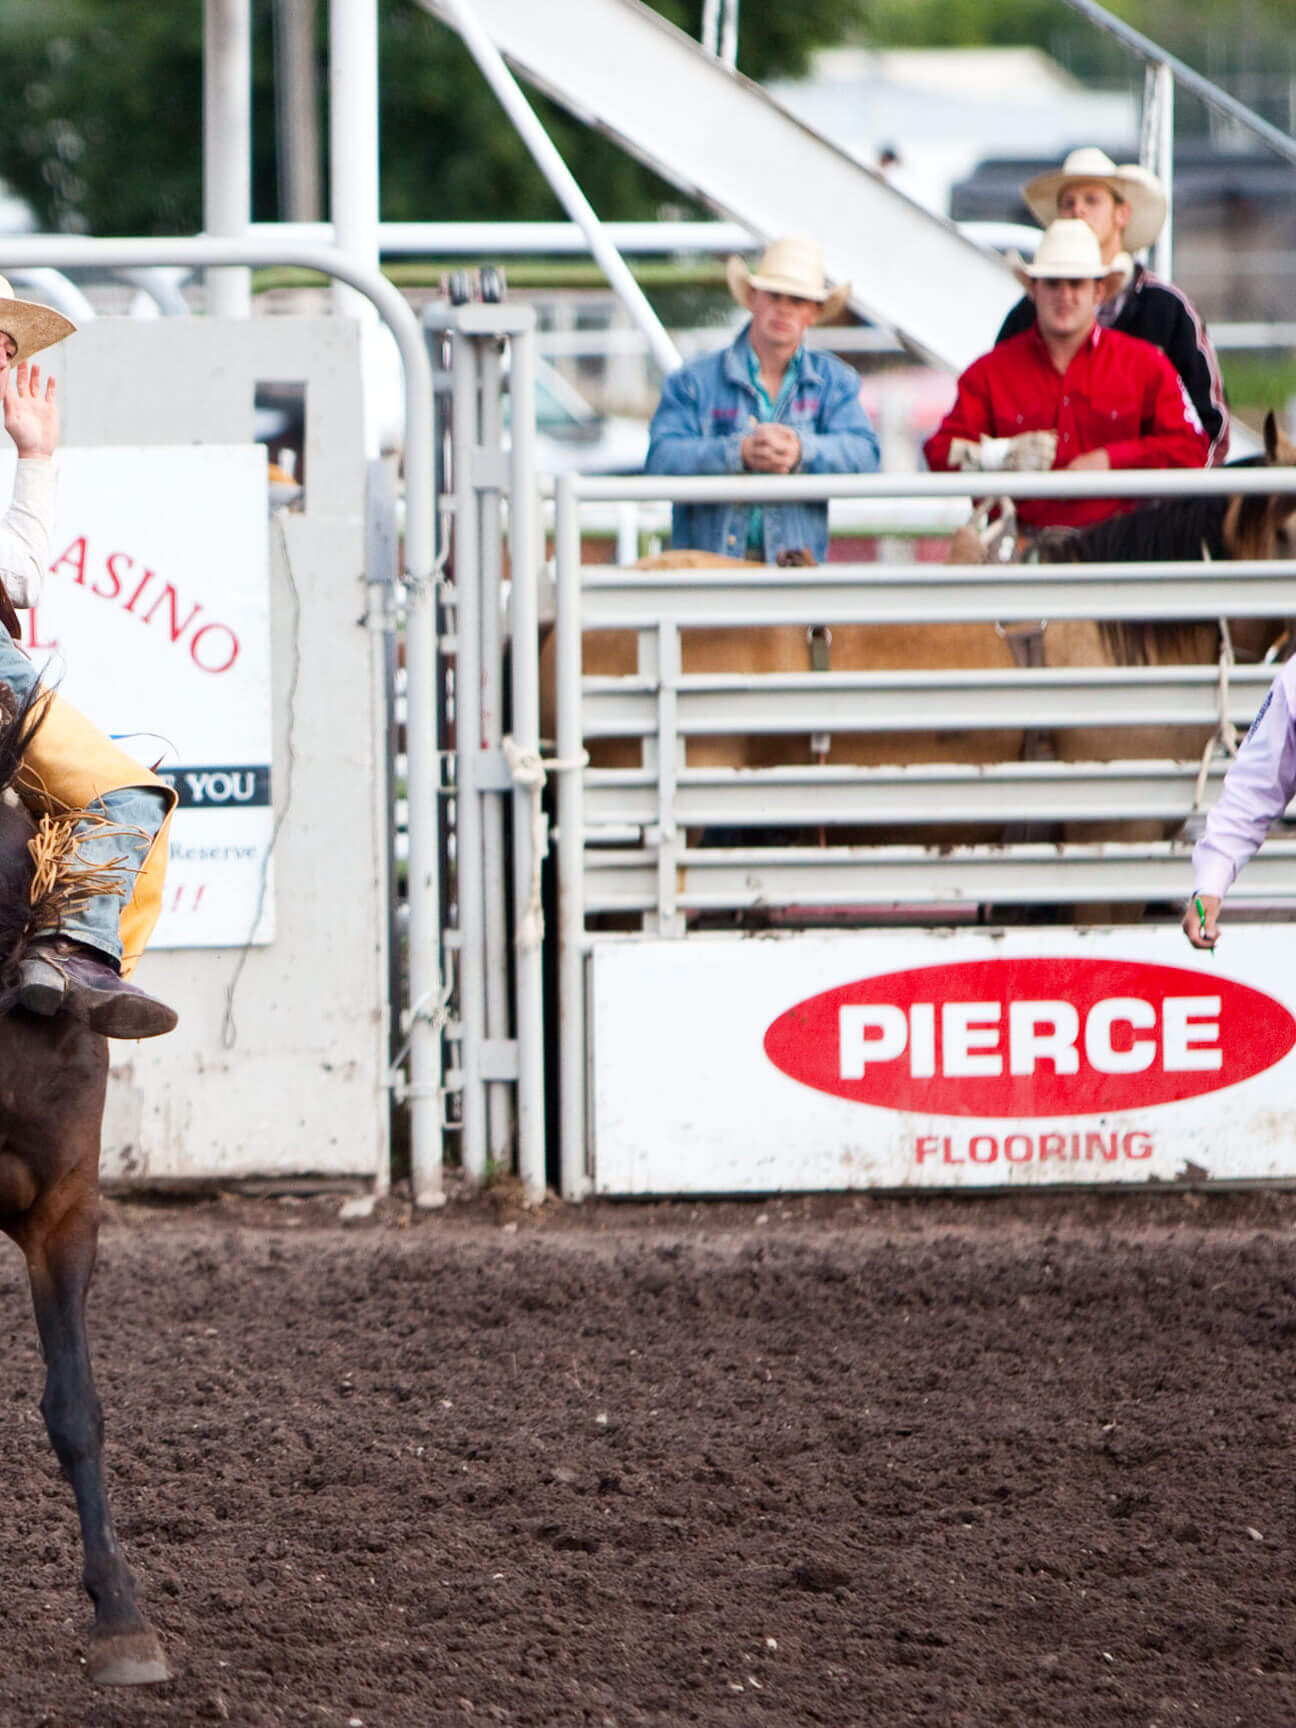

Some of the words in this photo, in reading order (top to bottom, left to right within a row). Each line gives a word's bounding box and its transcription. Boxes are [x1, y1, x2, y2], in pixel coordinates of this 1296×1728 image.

[49, 535, 239, 674] ASINO
[185, 772, 255, 802] YOU
[838, 996, 1223, 1081] PIERCE
[914, 1130, 1154, 1165] FLOORING
